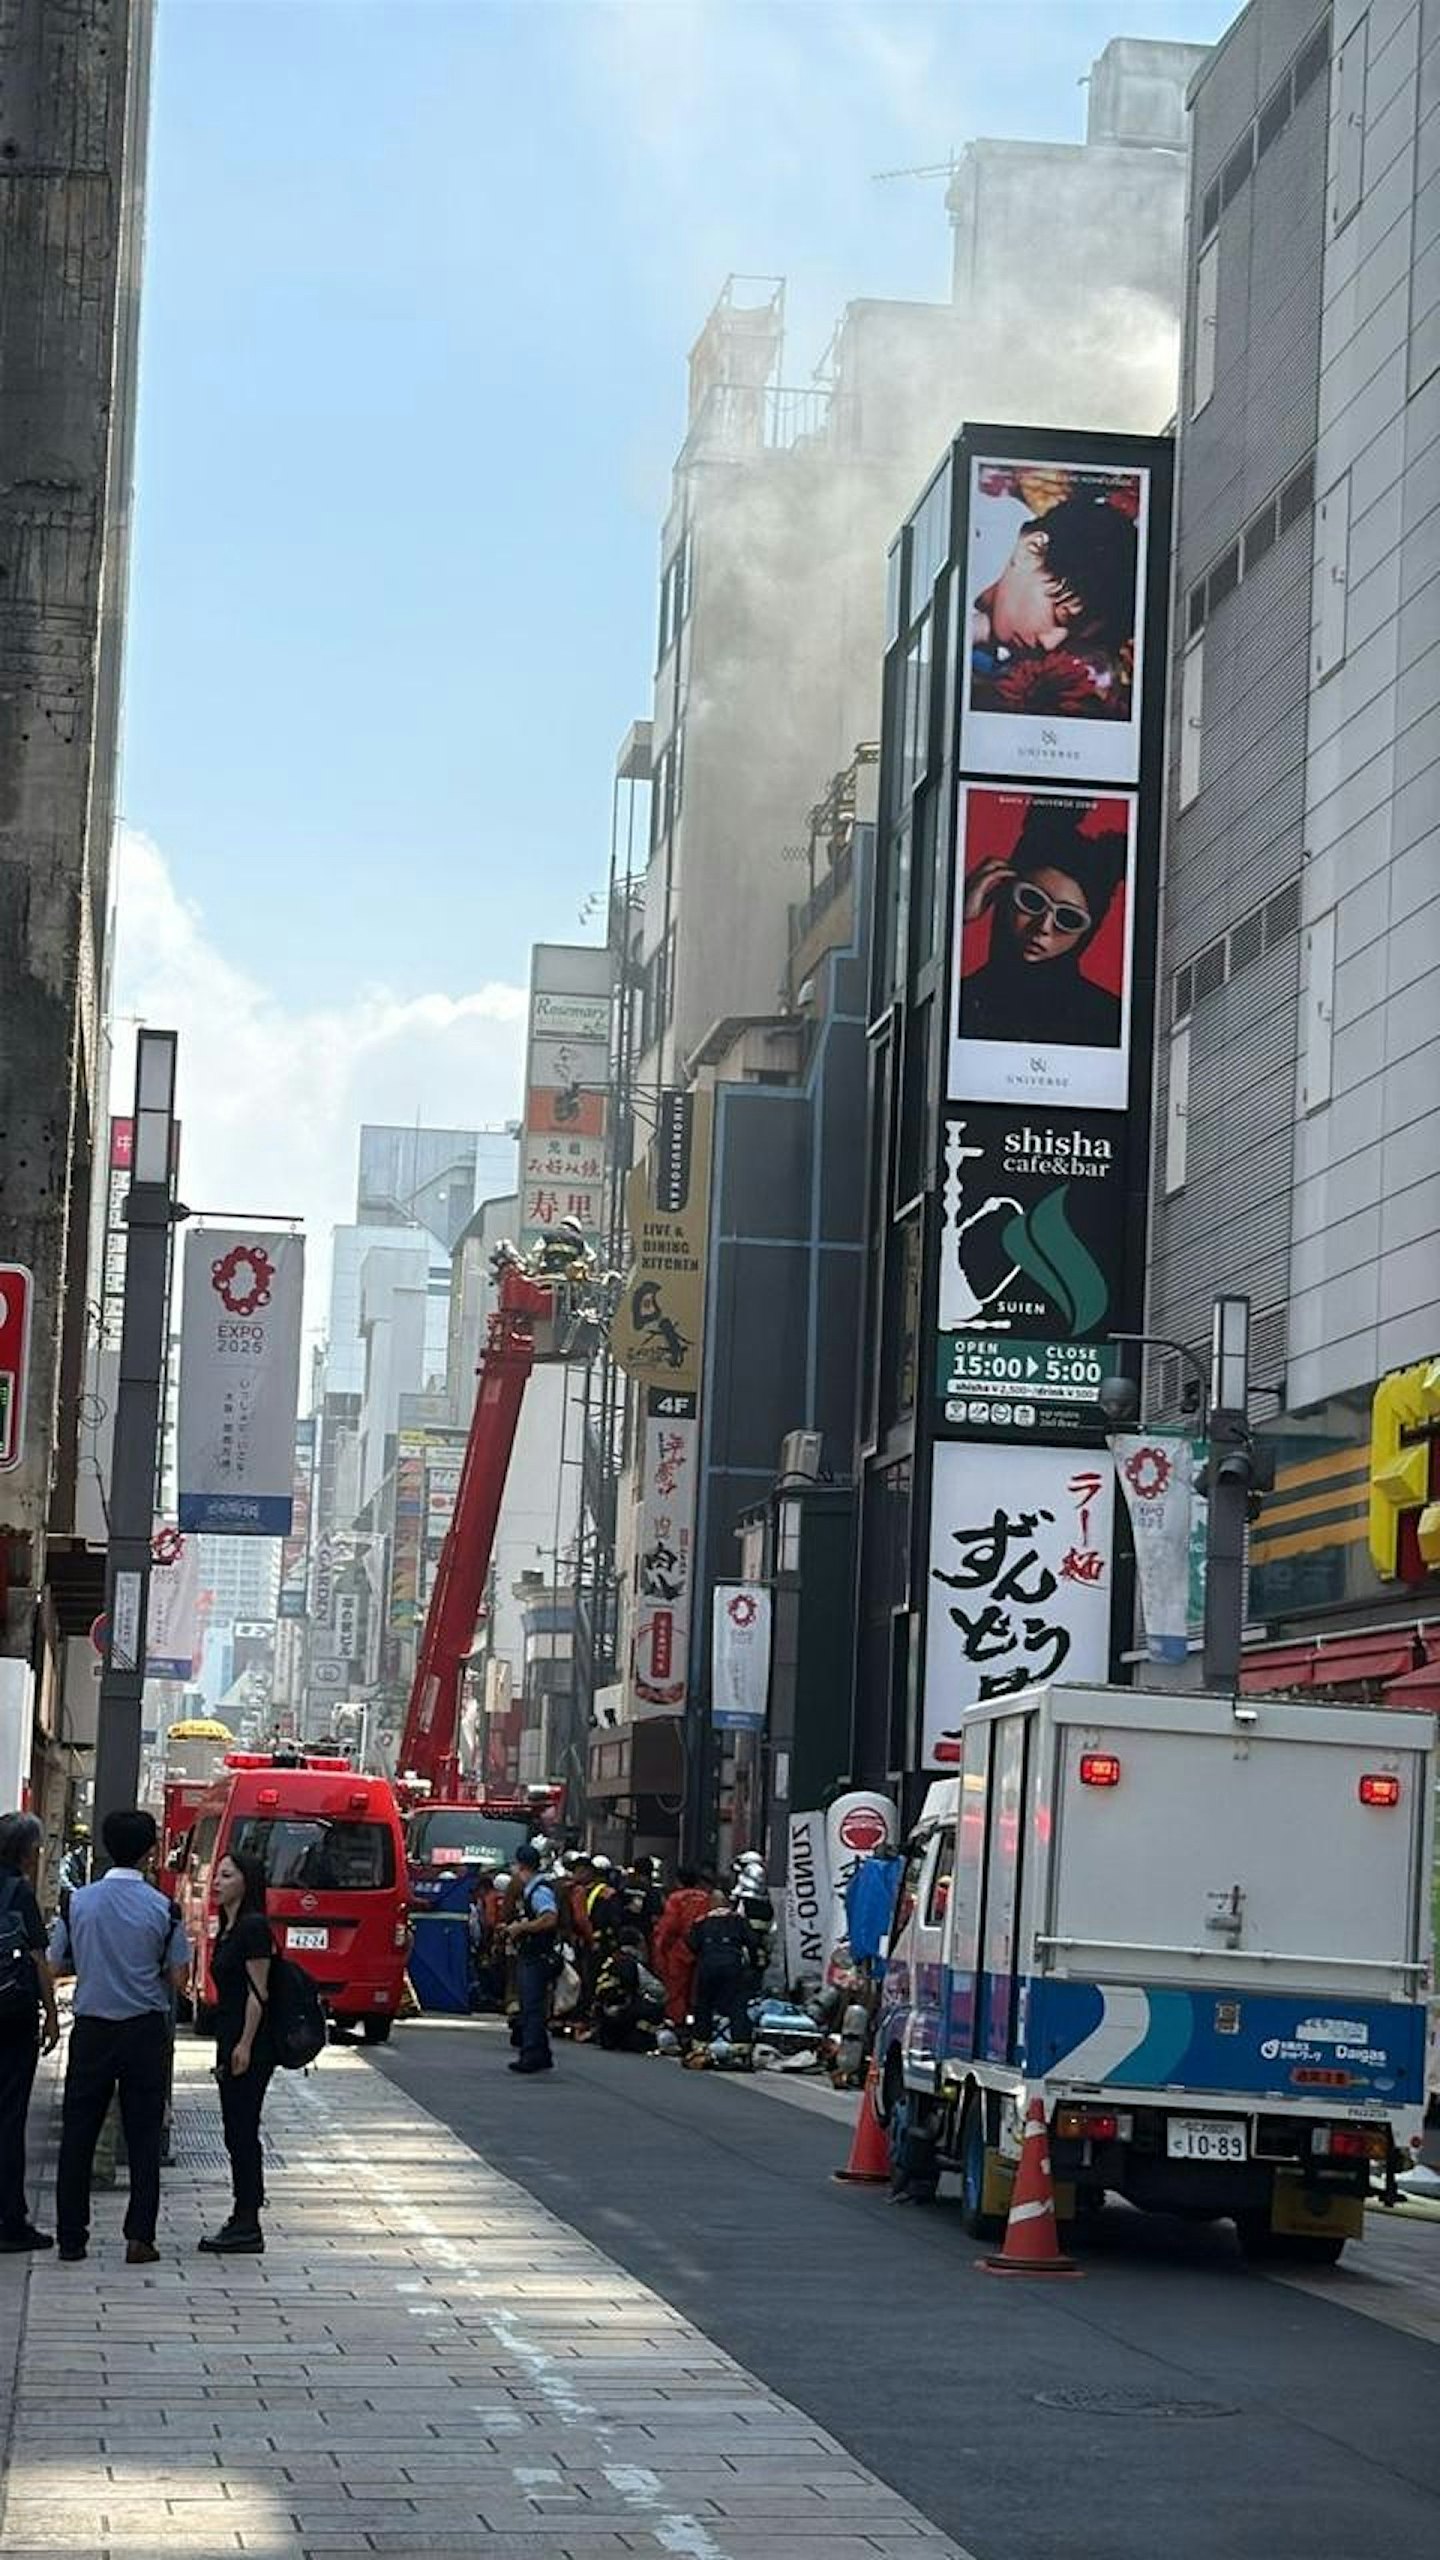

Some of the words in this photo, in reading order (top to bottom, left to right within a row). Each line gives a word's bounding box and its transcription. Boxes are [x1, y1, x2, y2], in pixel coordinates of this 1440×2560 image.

[1004, 1127, 1112, 1159] shisha
[1003, 1156, 1111, 1177] cafe&bar
[643, 1224, 672, 1236] LIVE
[643, 1240, 690, 1254] DINING
[642, 1257, 699, 1272] KITCHEN
[997, 1301, 1045, 1314] SUIEN
[218, 1326, 263, 1341] EXPO
[218, 1340, 263, 1354] 2025
[955, 1341, 999, 1355] OPEN
[1046, 1347, 1097, 1361] CLOSE
[953, 1356, 1021, 1378] 15:00
[1046, 1361, 1101, 1383] 5:00
[657, 1397, 689, 1414] 4F
[1188, 2133, 1242, 2157] 10-89
